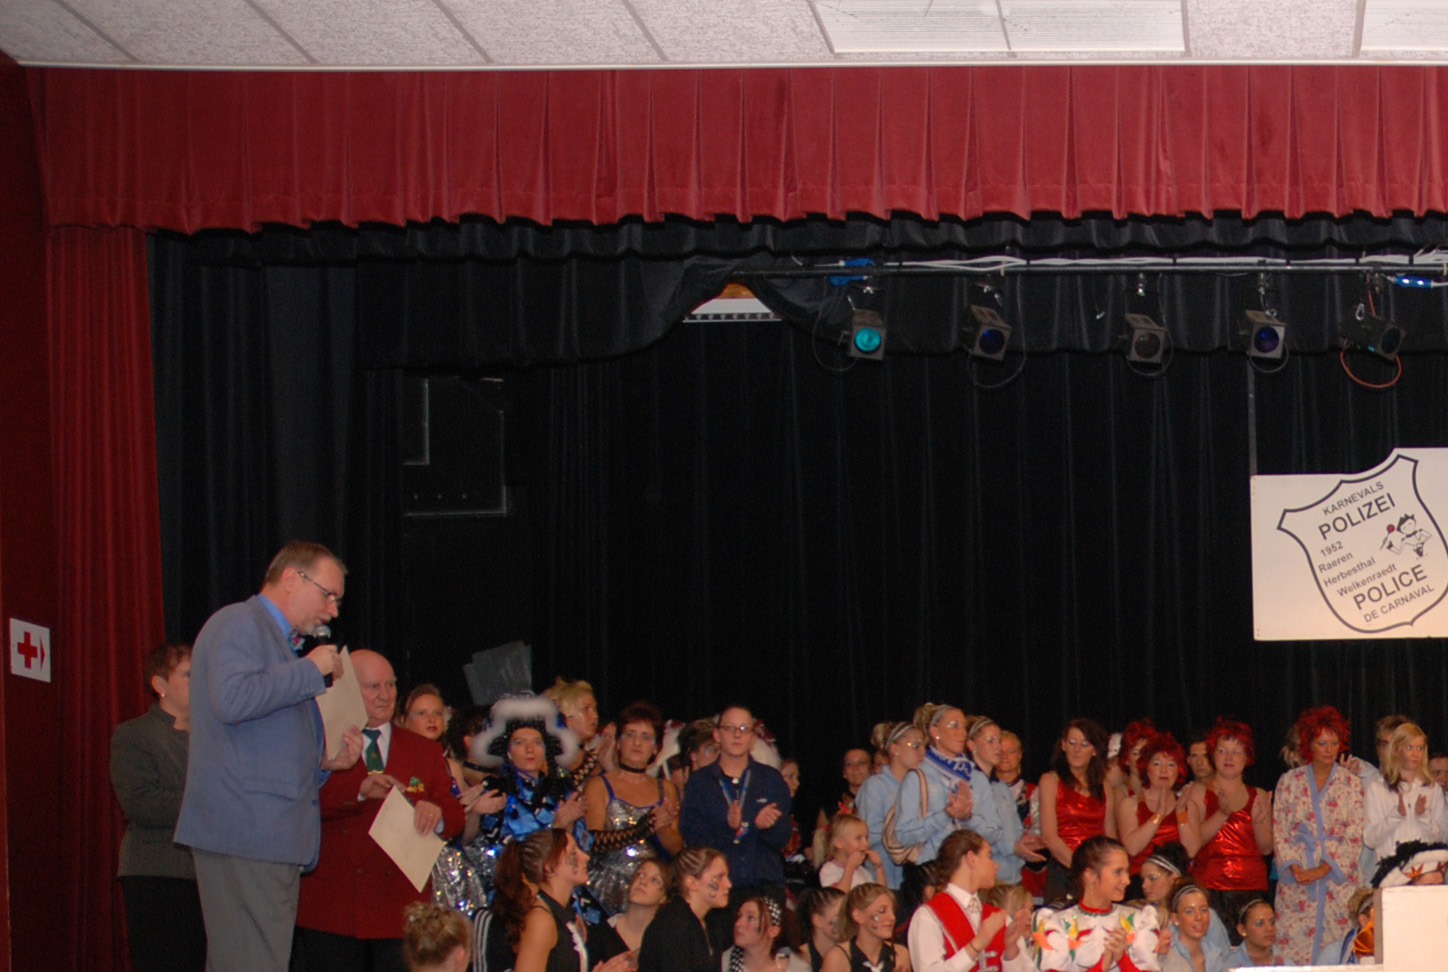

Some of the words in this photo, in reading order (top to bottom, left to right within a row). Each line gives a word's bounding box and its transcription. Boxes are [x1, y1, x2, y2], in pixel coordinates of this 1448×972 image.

[1323, 481, 1384, 516] KARNEVALS
[1318, 492, 1396, 540] POLIZEI
[1318, 552, 1353, 573] Raeren
[1320, 541, 1343, 557] 1952
[1323, 556, 1376, 587] Herbesthal
[1336, 563, 1397, 597] Welkenraedt
[1353, 564, 1428, 610] POLICE
[1363, 609, 1379, 623] DE
[1380, 584, 1435, 614] CARNAVAL
